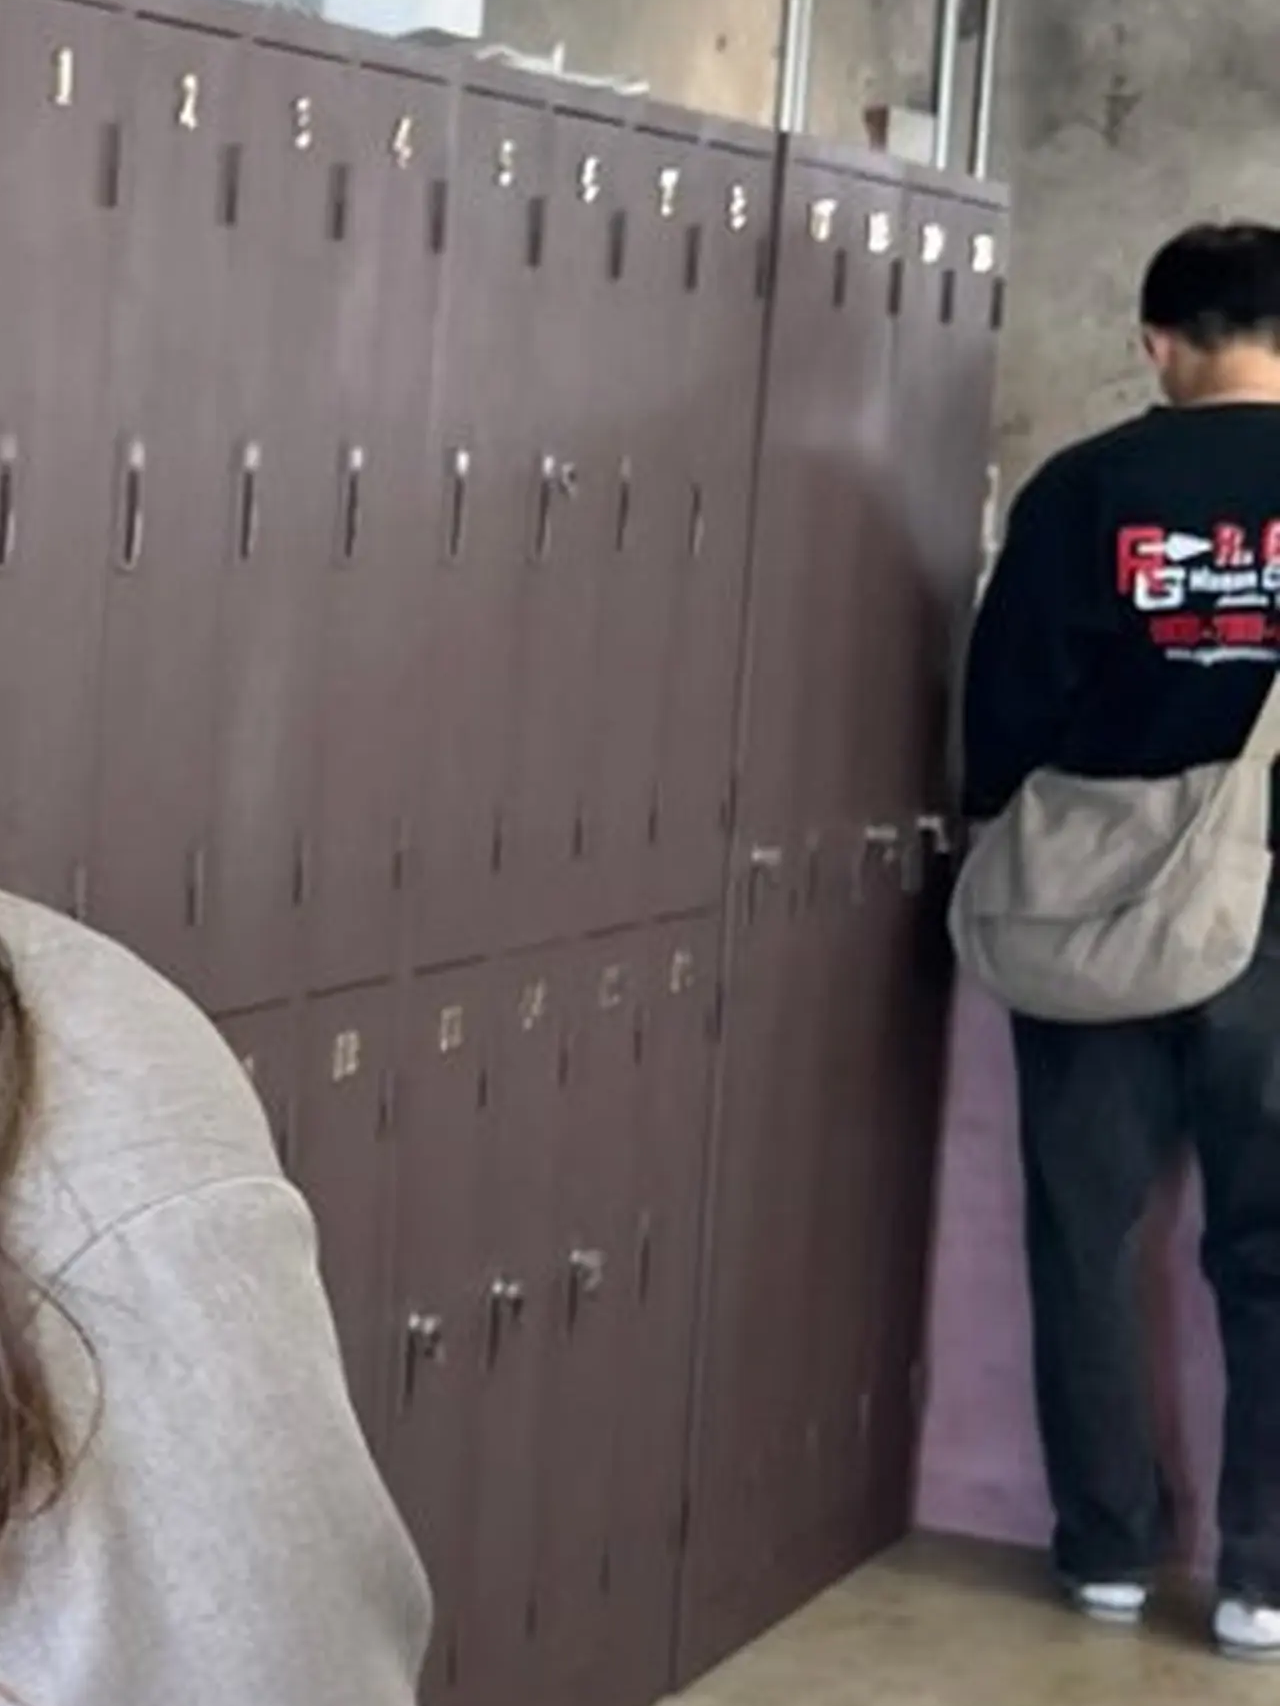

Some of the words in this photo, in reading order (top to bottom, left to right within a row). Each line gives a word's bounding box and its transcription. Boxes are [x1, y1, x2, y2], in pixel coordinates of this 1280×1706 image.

[56, 47, 74, 105] 1
[178, 73, 199, 130] 2
[393, 116, 413, 169] 4
